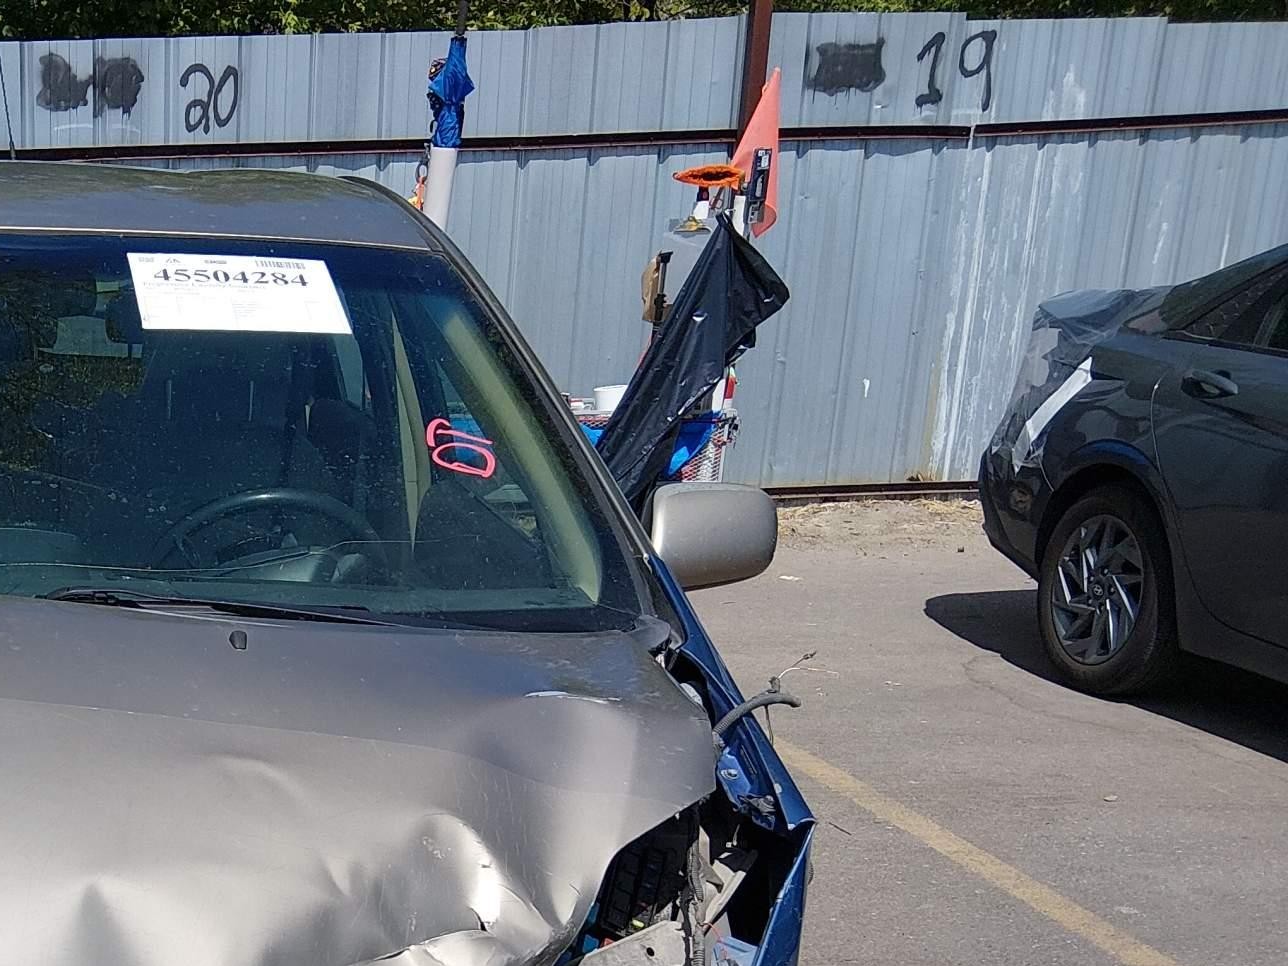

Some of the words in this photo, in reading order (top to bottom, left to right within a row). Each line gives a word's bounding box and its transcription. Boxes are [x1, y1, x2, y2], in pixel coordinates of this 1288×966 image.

[180, 63, 239, 135] 20
[915, 29, 998, 113] 19
[153, 267, 309, 287] 45504284
